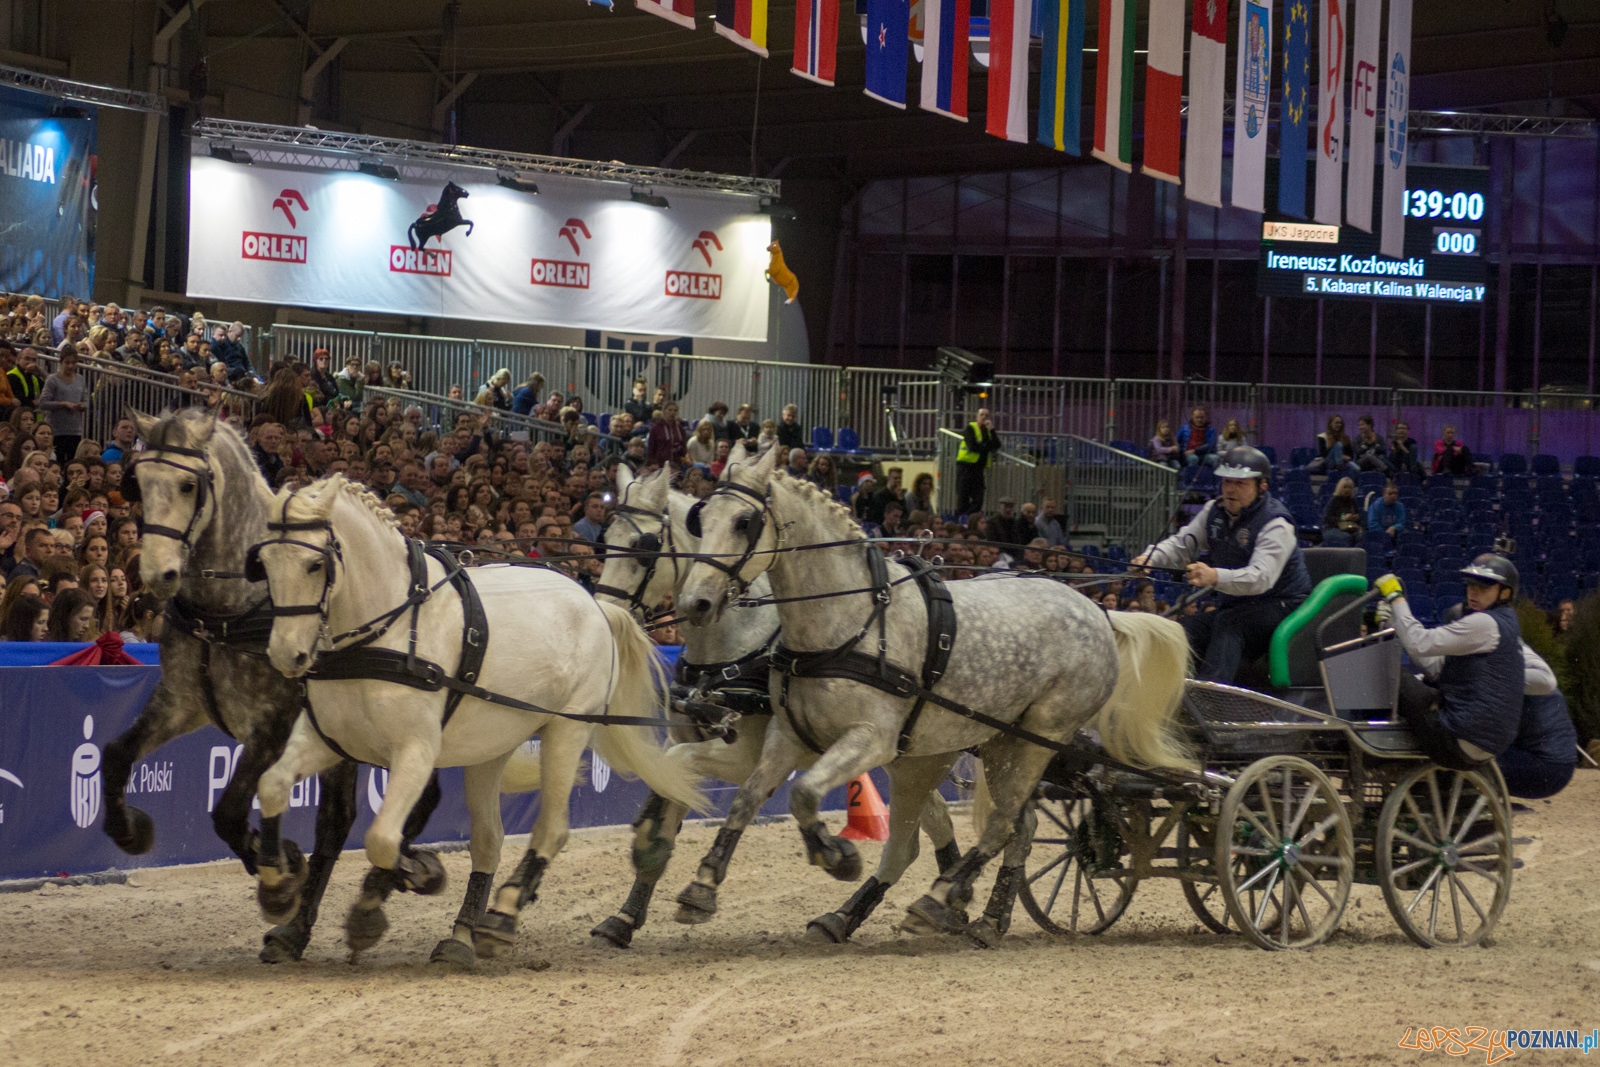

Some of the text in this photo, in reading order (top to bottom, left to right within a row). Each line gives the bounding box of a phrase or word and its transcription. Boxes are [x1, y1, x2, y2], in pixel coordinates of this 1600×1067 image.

[0, 138, 55, 184] ALIADA
[1267, 225, 1287, 237] JKS
[1437, 232, 1476, 253] 000
[244, 234, 306, 261] ORLEN
[391, 248, 450, 274] ORLEN
[532, 261, 588, 286] ORLEN
[1267, 250, 1424, 277] Ireneusz Kozłowski
[667, 273, 720, 297] ORLEN
[1306, 276, 1319, 292] 5.
[1321, 278, 1372, 294] Kabaret
[1373, 280, 1413, 297] Kalina
[1415, 283, 1473, 302] Walencja
[140, 761, 174, 793] Polski
[848, 780, 862, 807] 2
